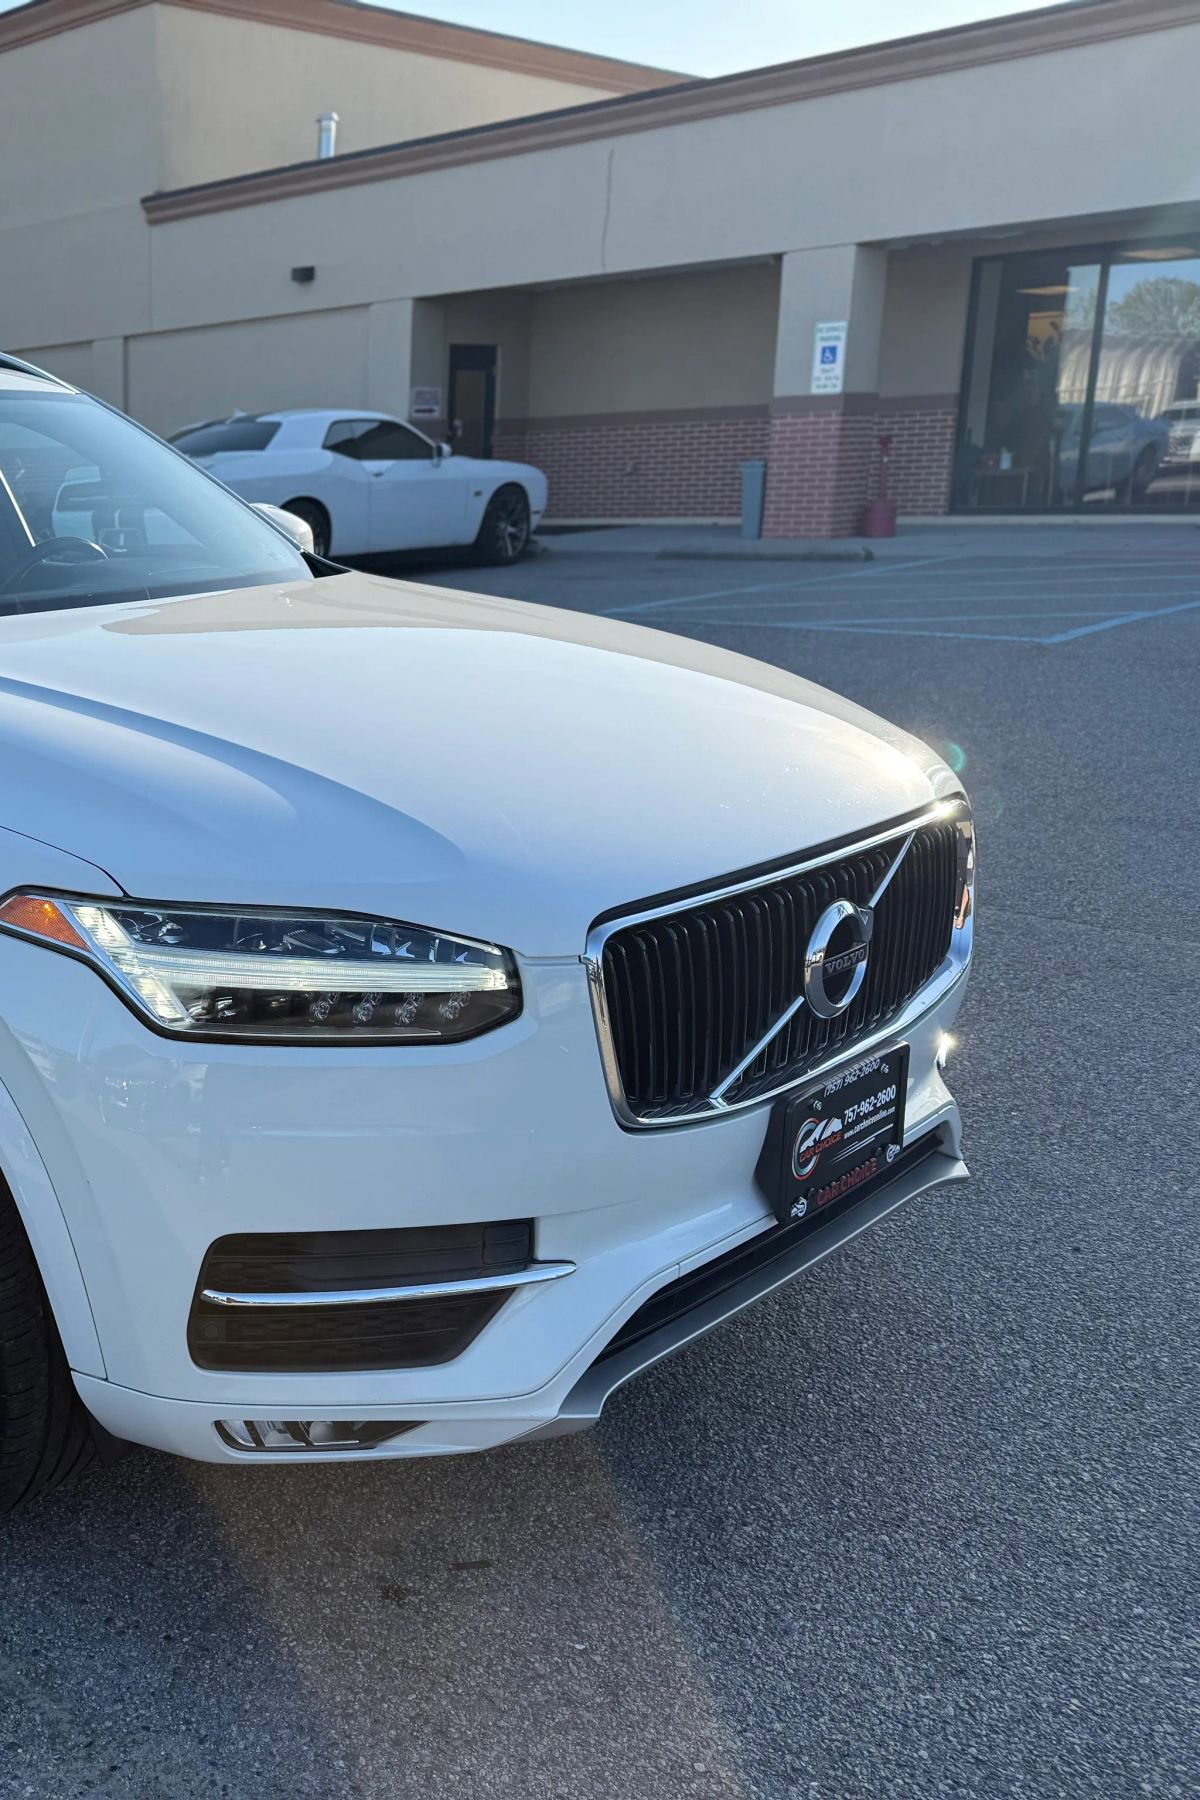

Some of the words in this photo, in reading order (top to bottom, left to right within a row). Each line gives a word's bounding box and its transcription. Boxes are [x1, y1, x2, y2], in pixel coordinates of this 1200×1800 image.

[825, 949, 865, 974] VOLVO
[844, 1084, 896, 1126] 757-962-2600
[799, 1149, 815, 1164] CAR
[814, 1131, 843, 1155] CHOICE
[816, 1181, 840, 1206] CAR
[840, 1157, 878, 1192] CHOICE
